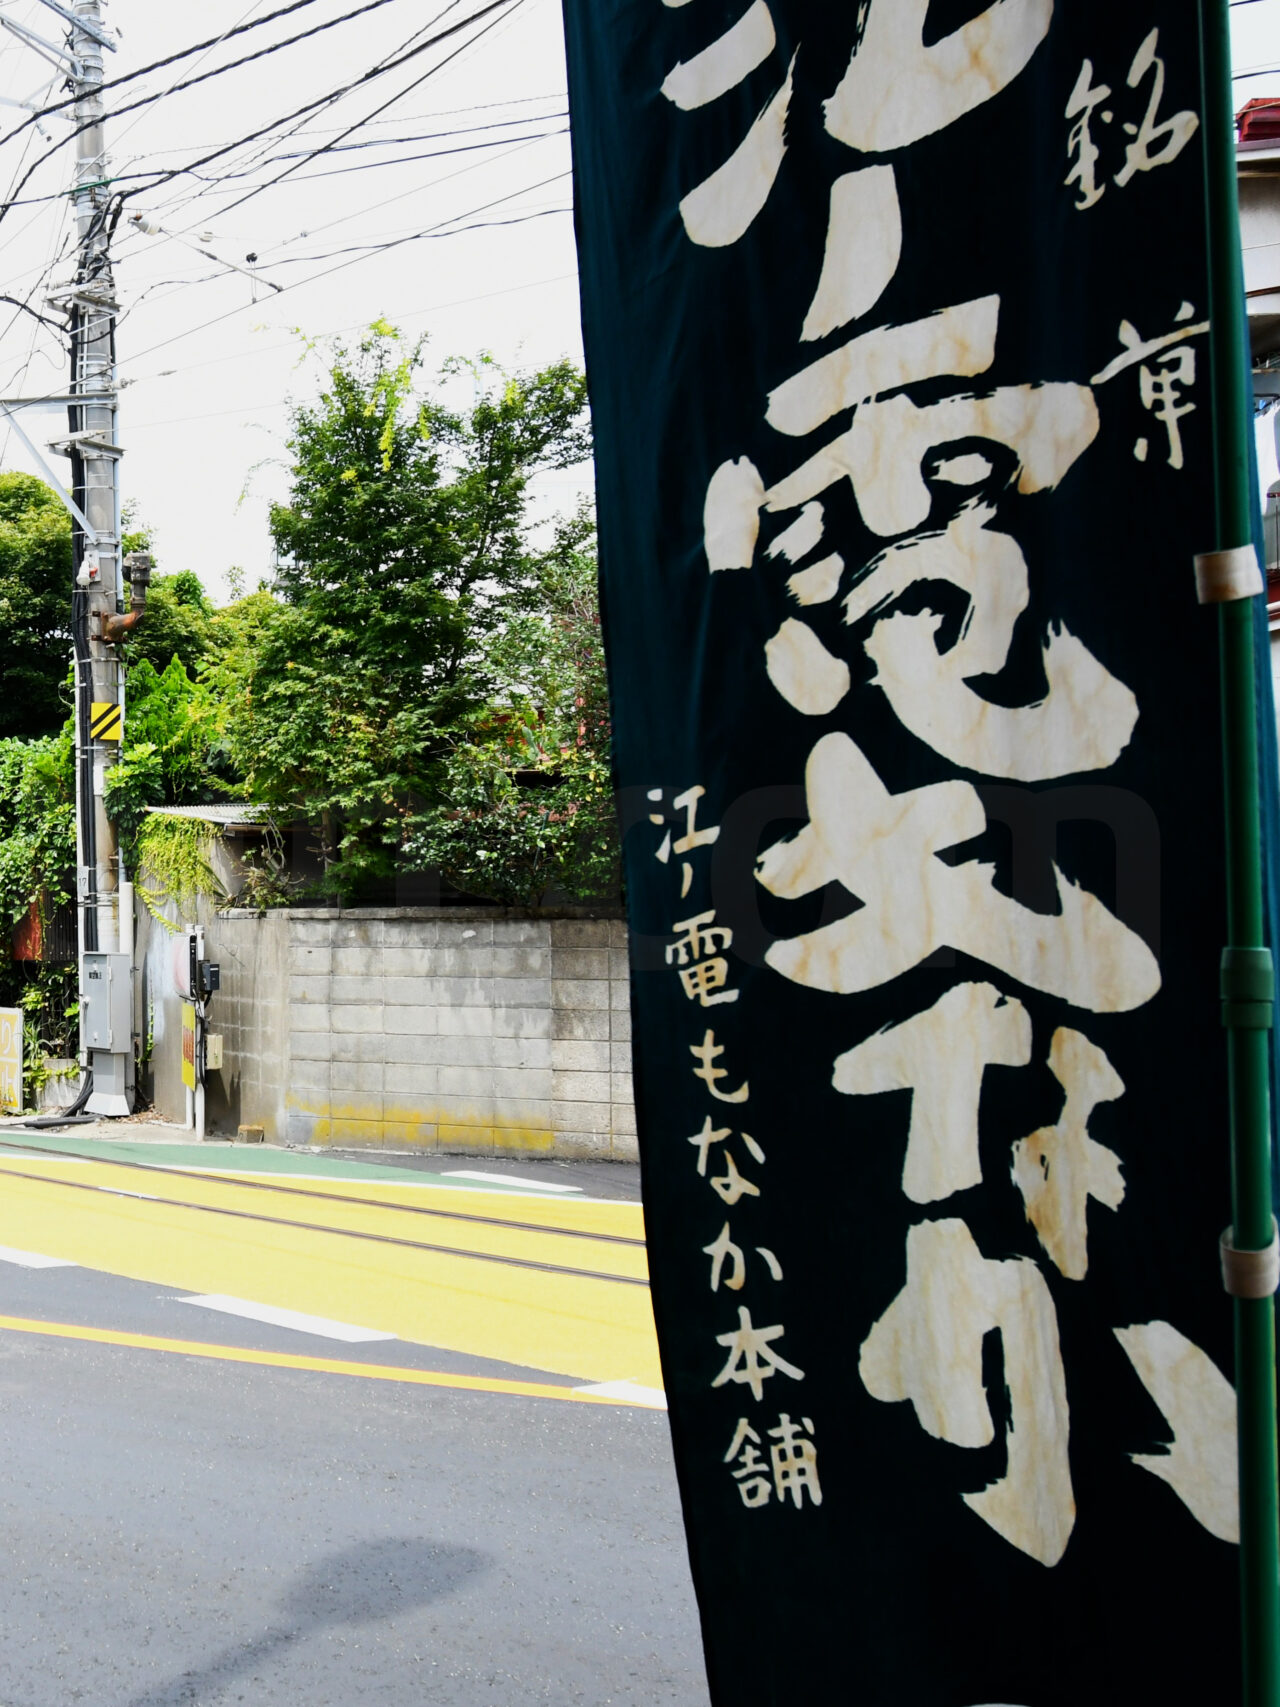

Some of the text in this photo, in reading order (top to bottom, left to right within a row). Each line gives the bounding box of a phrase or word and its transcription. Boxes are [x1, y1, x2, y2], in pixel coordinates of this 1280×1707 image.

[647, 784, 823, 1511] 江ノ電もなか本舗
